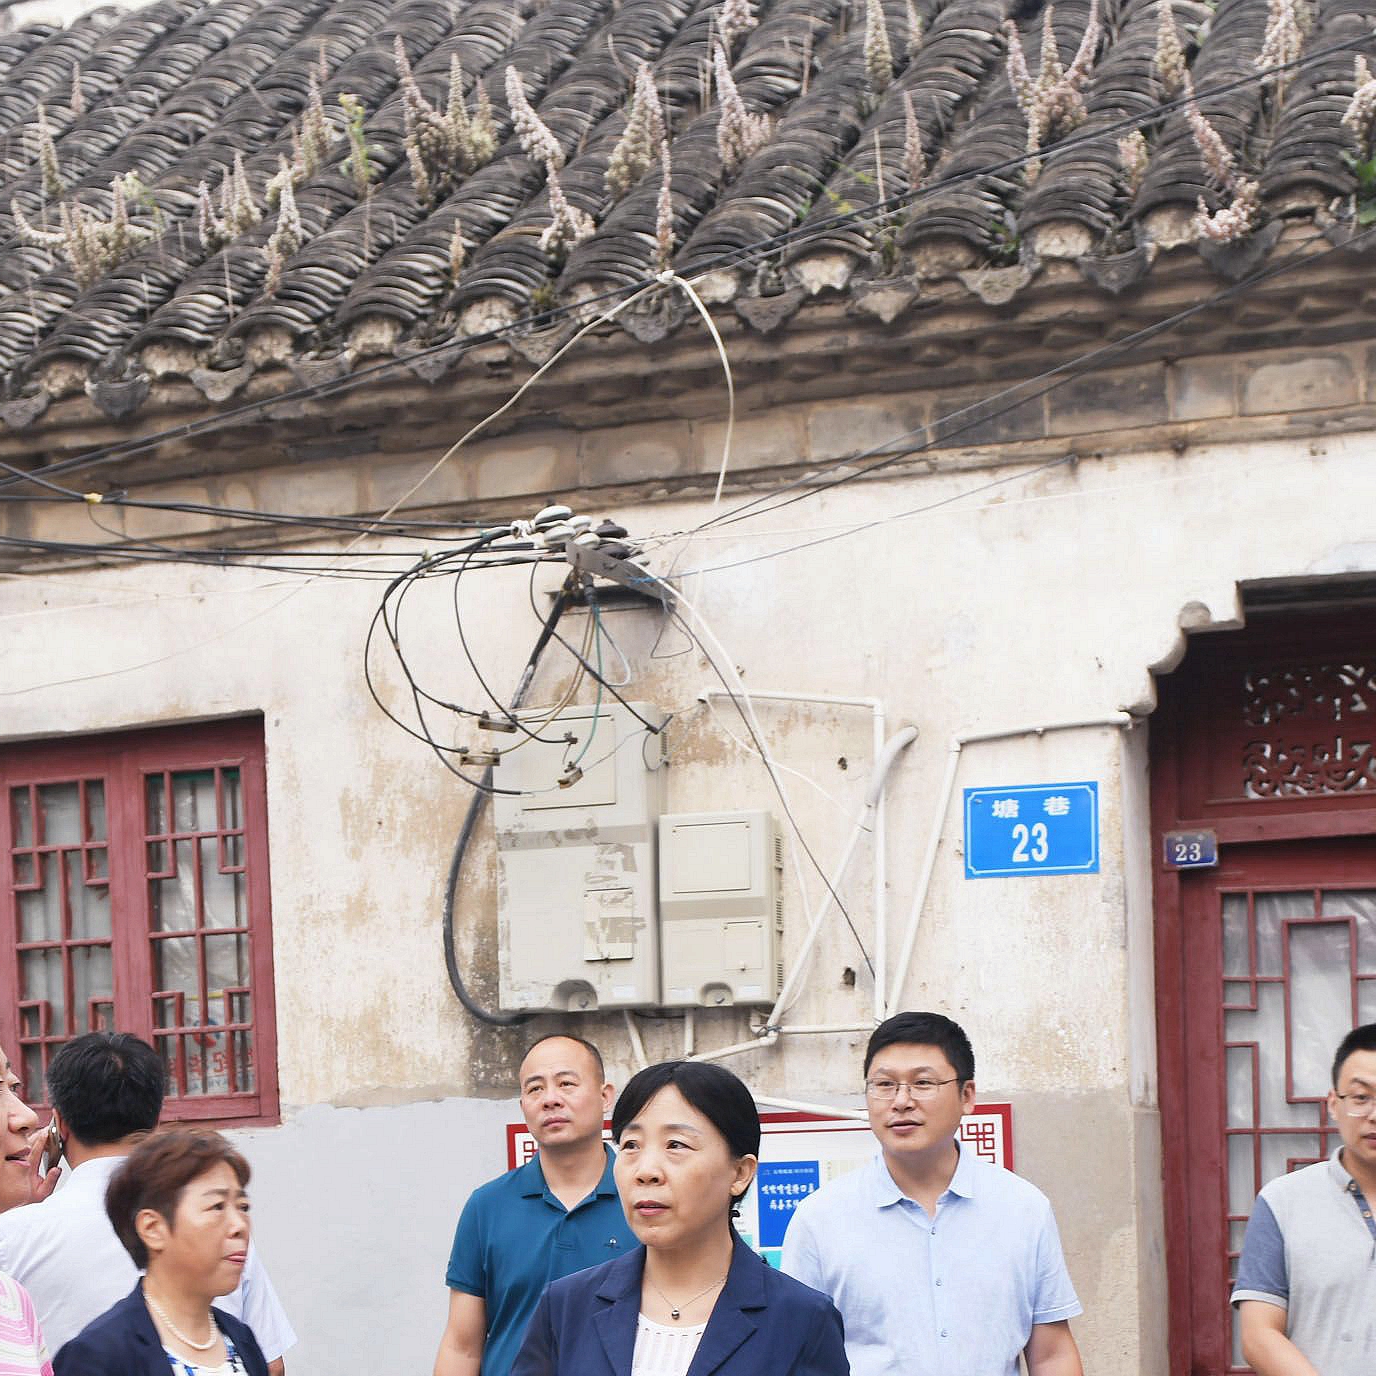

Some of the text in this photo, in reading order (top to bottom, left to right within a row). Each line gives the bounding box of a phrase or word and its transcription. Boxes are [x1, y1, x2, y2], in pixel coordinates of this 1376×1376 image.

[991, 796, 1071, 818] 塘巷
[1012, 822, 1048, 862] 23
[1175, 843, 1202, 862] 23
